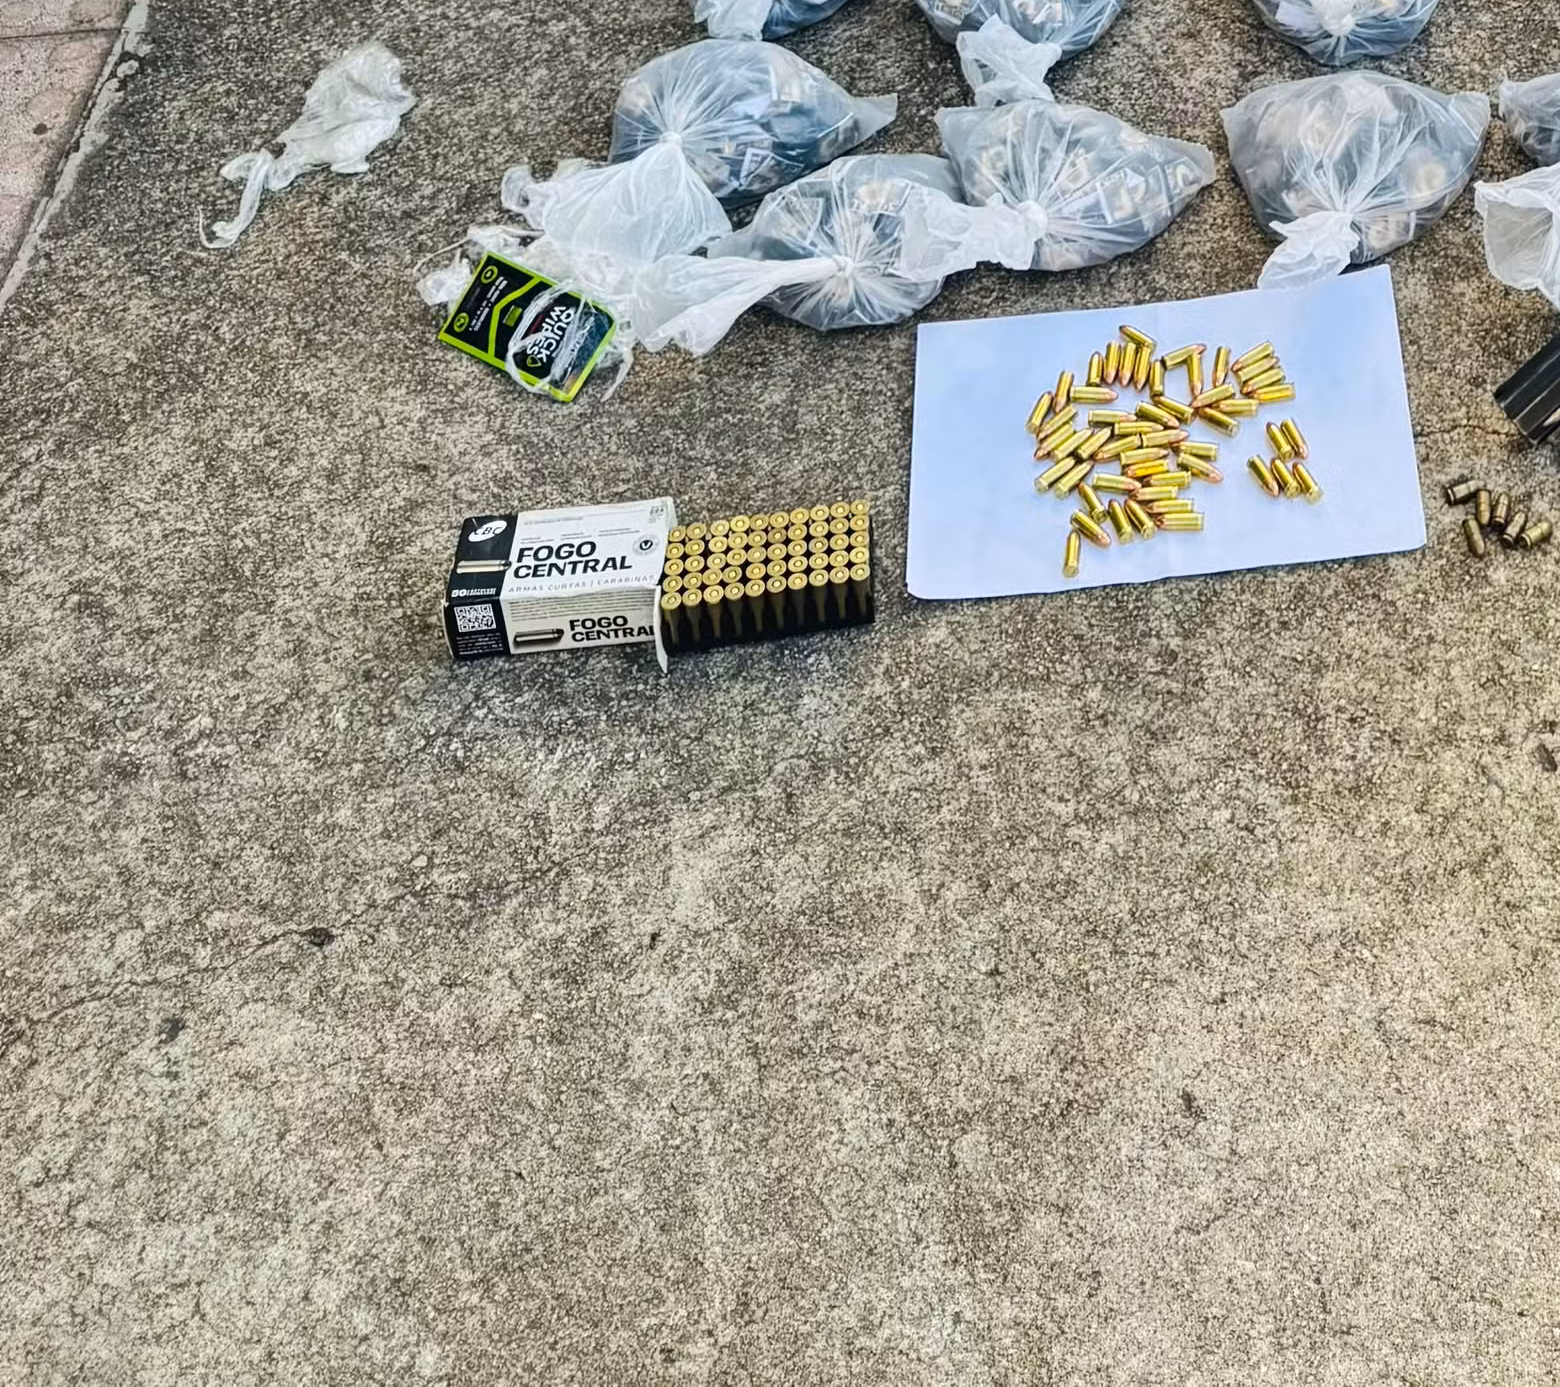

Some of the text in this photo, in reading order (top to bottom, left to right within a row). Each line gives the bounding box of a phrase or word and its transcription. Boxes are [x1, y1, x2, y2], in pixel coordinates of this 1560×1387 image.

[538, 308, 575, 363] QUICK
[516, 541, 597, 563] FOGO
[513, 555, 633, 579] CENTRAL
[569, 615, 628, 631] FOGO
